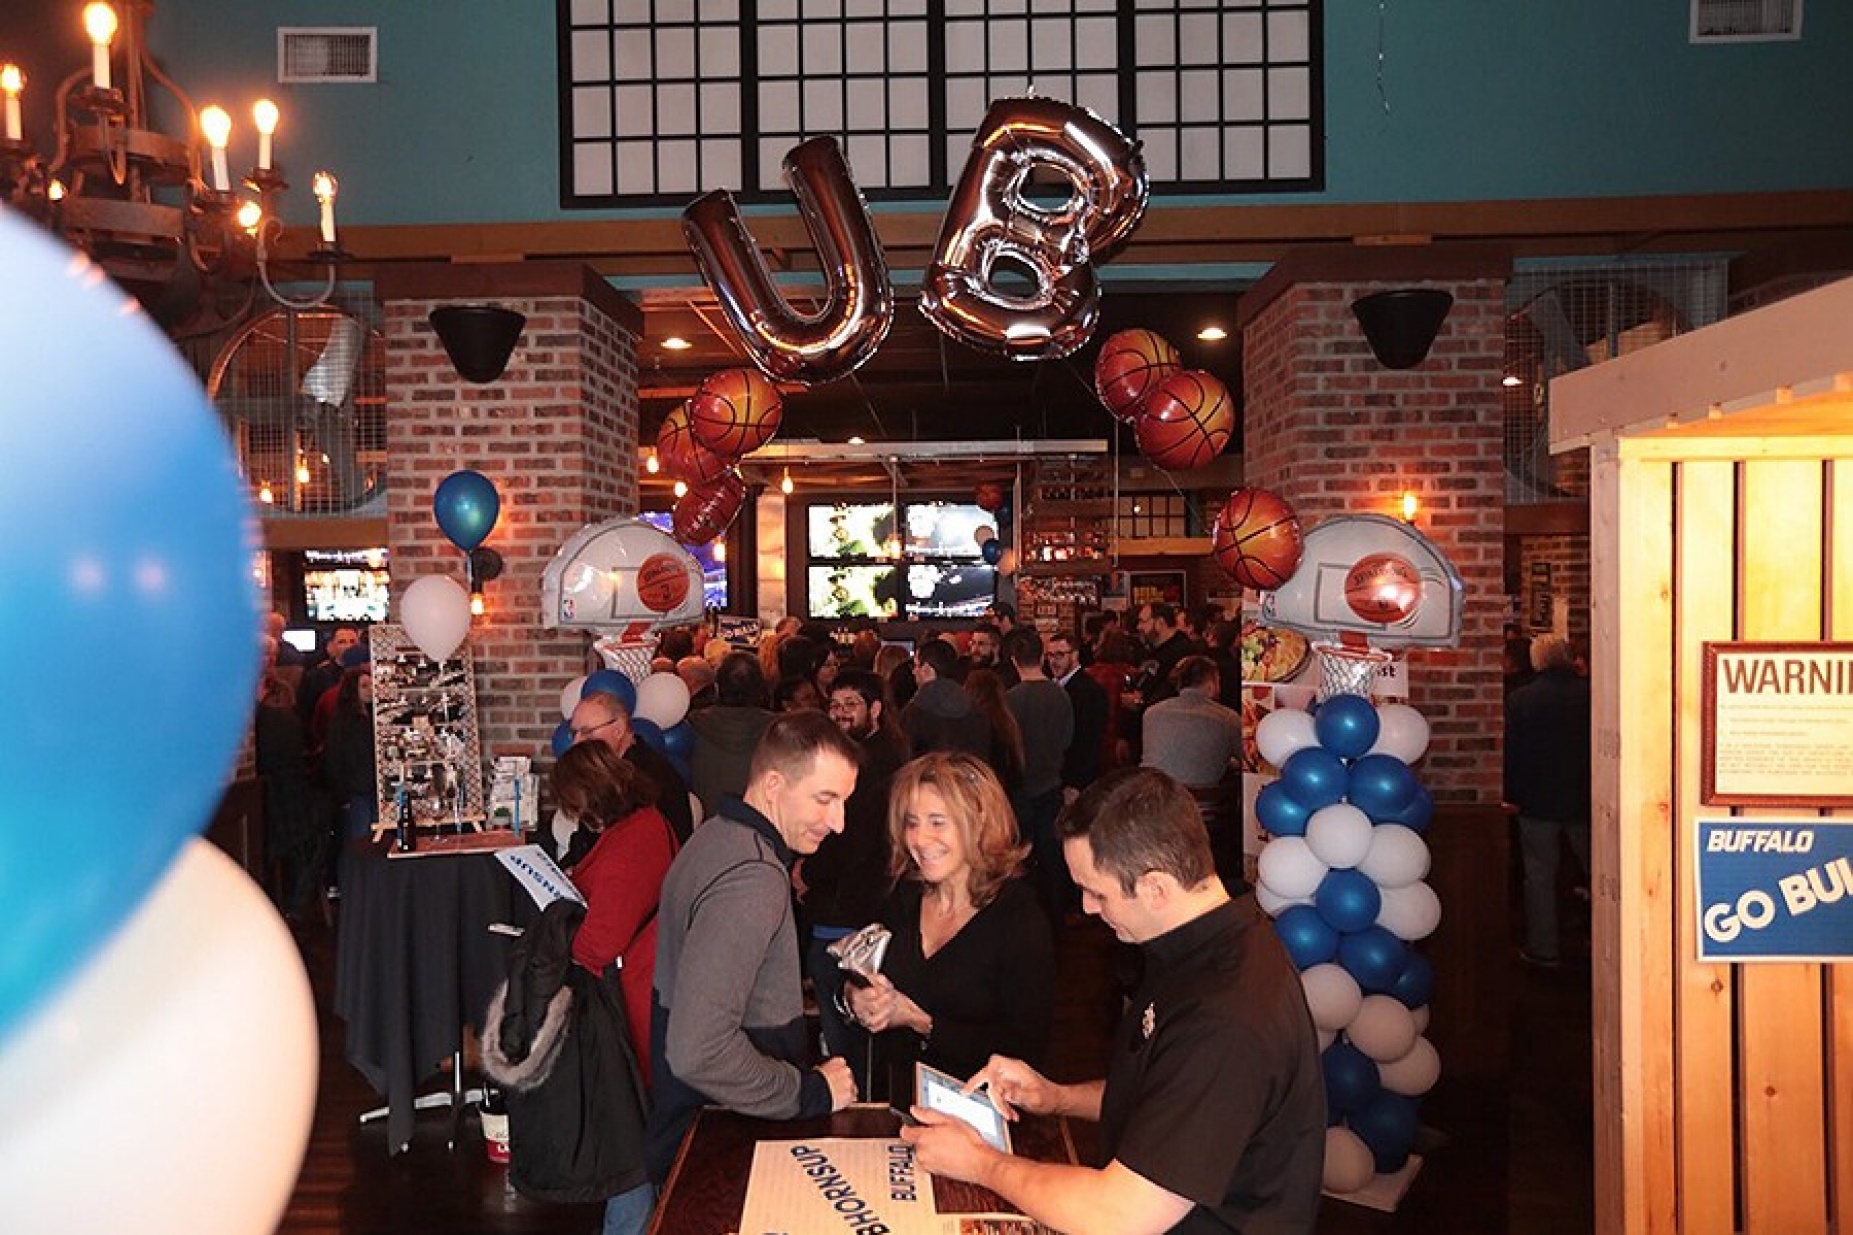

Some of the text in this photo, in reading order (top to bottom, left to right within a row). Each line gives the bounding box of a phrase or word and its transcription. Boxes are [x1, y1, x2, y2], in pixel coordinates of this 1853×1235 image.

[1722, 659, 1853, 694] WARNI
[1706, 830, 1814, 853] BUFFALO
[1703, 889, 1776, 943] GO
[887, 1144, 918, 1201] BUFFALO
